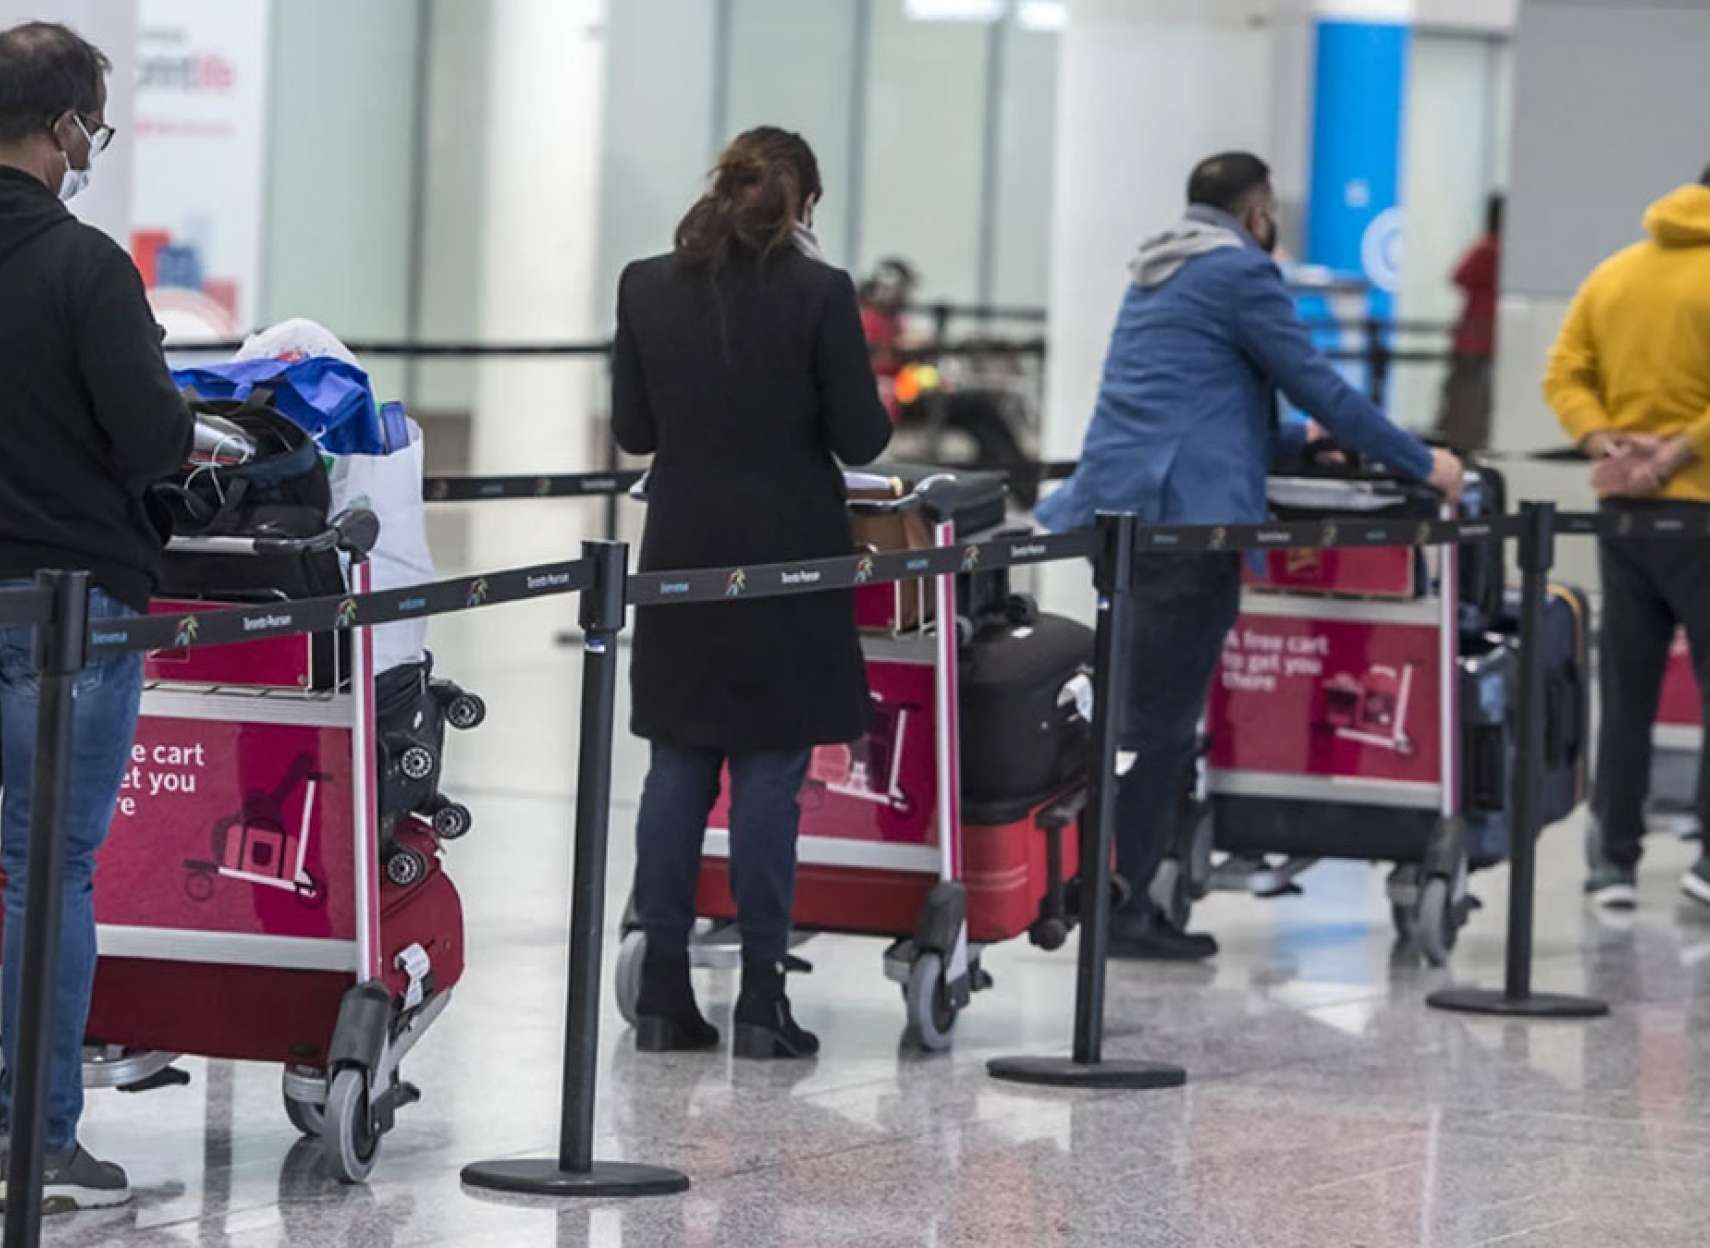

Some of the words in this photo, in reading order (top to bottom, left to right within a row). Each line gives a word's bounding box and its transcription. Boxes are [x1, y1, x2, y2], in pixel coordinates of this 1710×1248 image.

[1242, 629, 1283, 649] free
[1286, 635, 1328, 656] cart
[1248, 653, 1280, 674] get
[1284, 657, 1323, 677] you
[1222, 671, 1275, 692] there
[152, 743, 205, 767] cart
[148, 772, 196, 796] you
